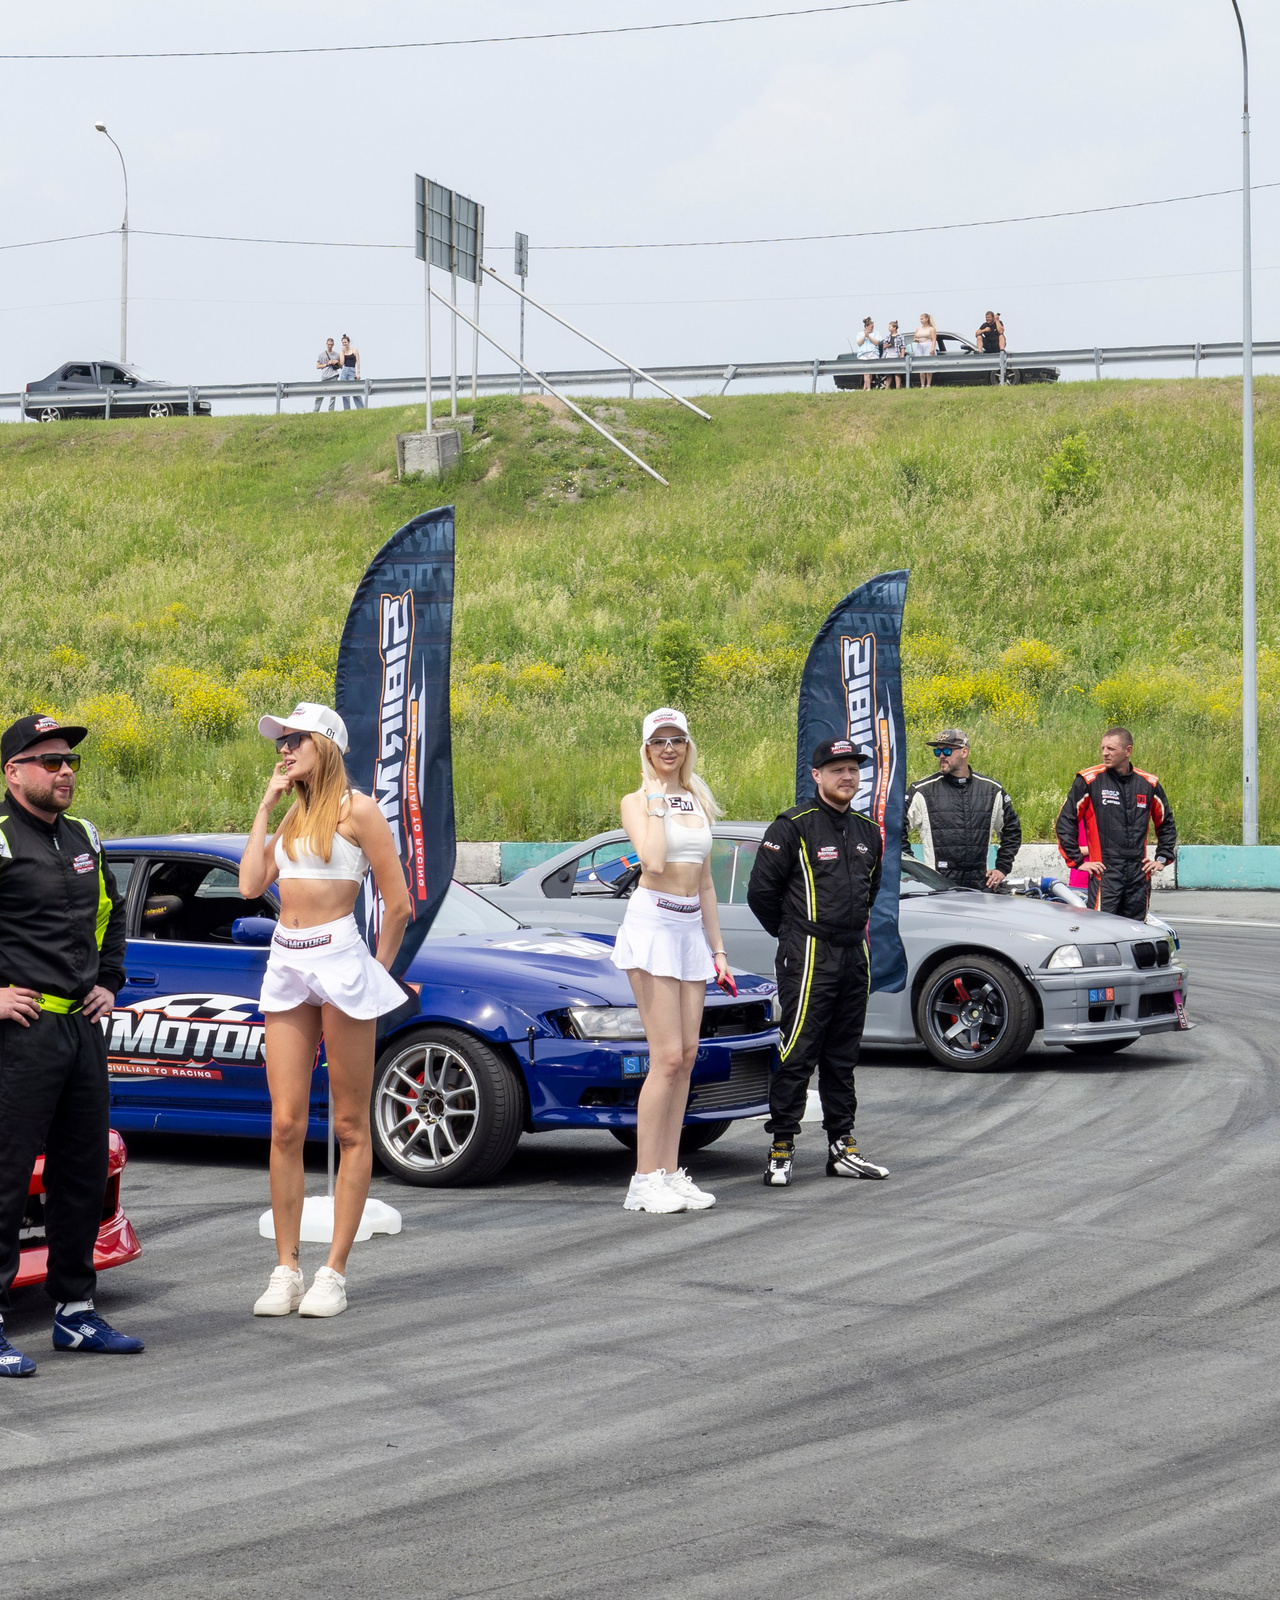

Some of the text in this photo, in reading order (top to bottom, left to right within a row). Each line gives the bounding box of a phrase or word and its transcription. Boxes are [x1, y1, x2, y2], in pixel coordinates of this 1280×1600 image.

[325, 727, 336, 739] 01
[1090, 988, 1114, 1001] SKR
[109, 1011, 266, 1061] MOTOR
[626, 1058, 651, 1072] SK
[154, 1067, 168, 1075] TO
[172, 1069, 213, 1078] RACING
[79, 1325, 96, 1336] OMP
